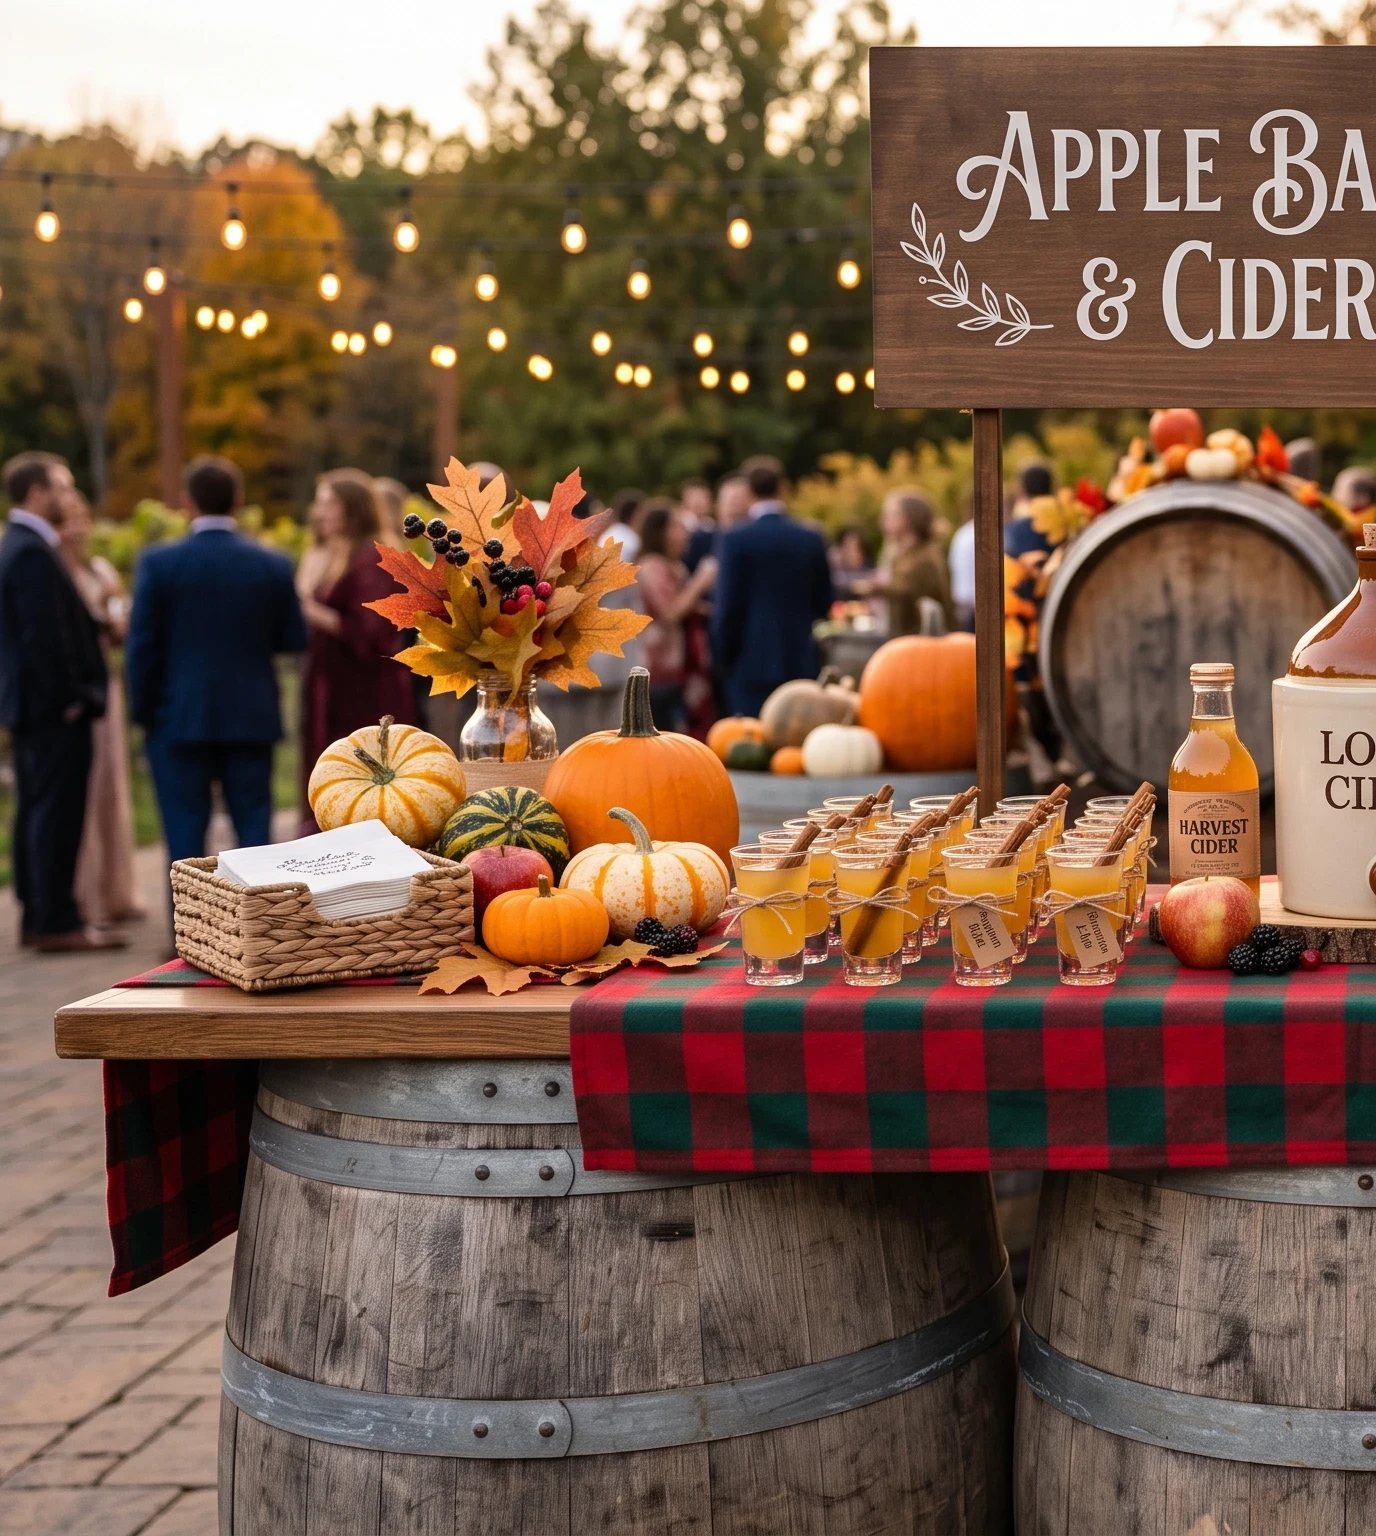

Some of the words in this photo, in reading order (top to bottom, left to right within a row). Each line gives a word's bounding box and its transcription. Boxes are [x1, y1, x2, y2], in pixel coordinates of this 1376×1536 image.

[957, 110, 1221, 243] APPLE
[1076, 256, 1137, 341] &
[1179, 819, 1249, 836] HARVEST
[1190, 838, 1239, 854] CIDER
